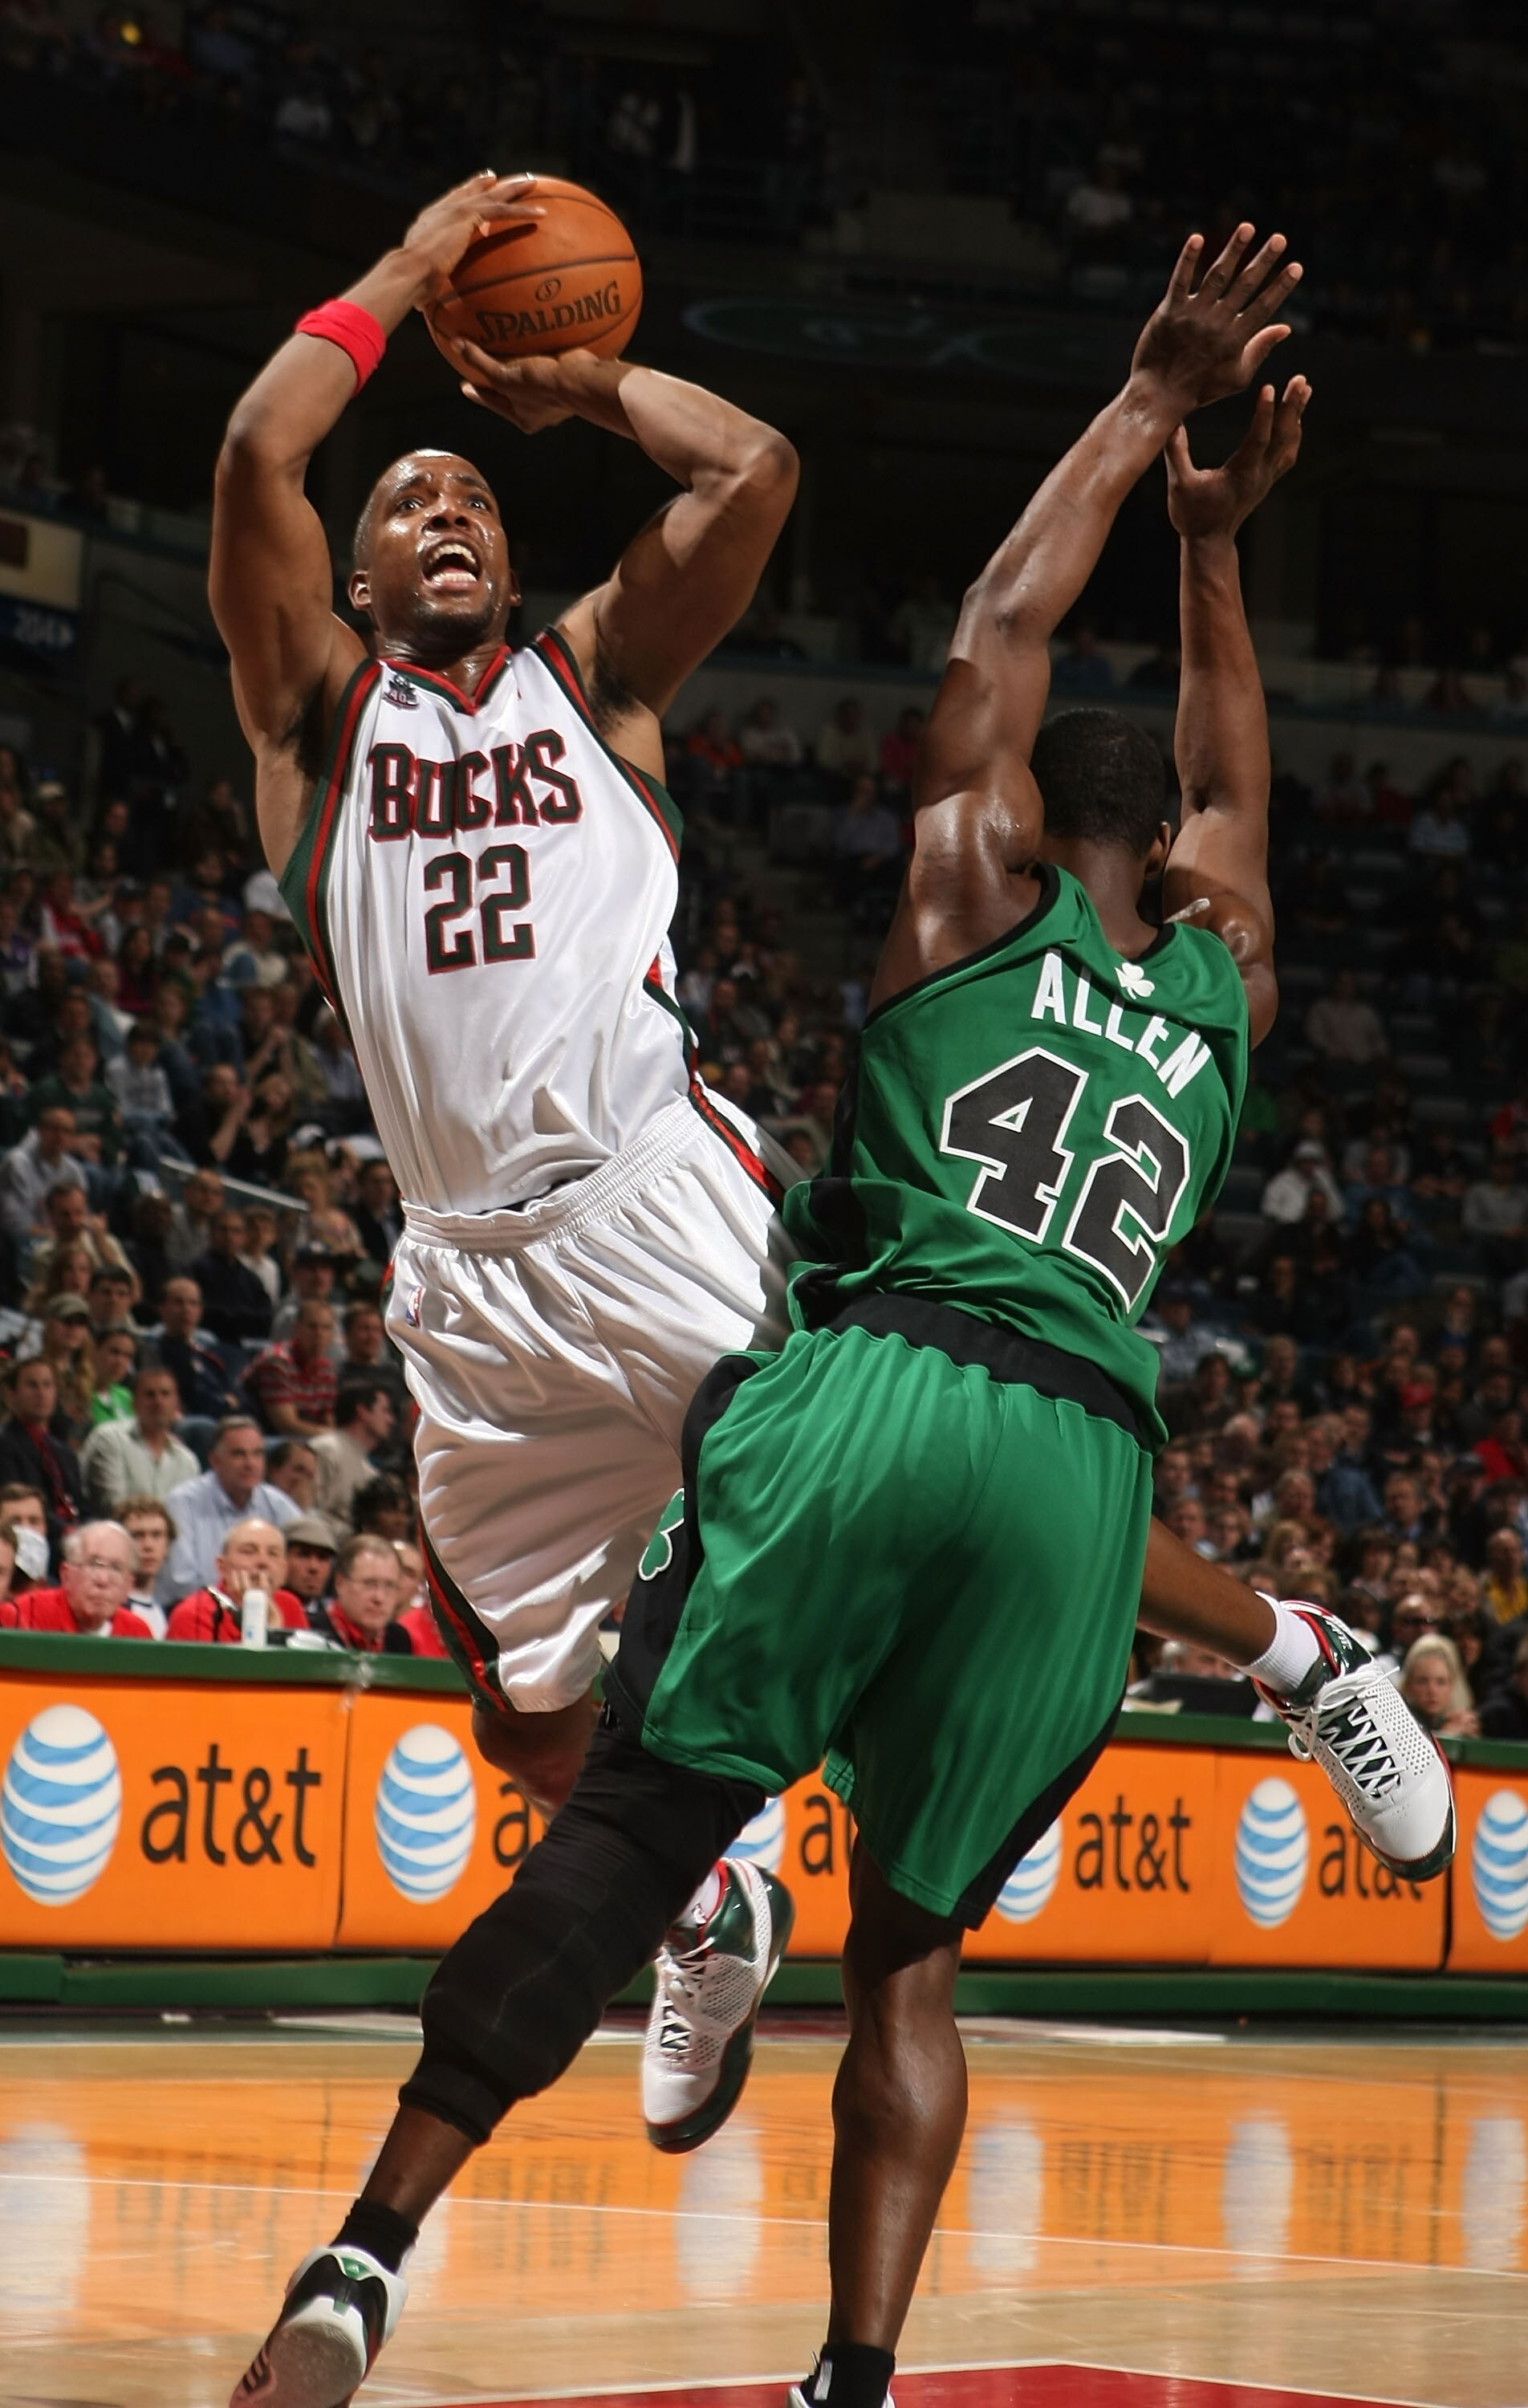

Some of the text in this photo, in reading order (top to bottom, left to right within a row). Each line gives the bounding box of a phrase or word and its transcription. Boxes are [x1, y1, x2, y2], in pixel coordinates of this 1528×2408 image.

[475, 280, 621, 343] SPALDING
[368, 728, 584, 843] BUCKS
[424, 843, 537, 976] 22
[1030, 947, 1213, 1100] ALLEN
[939, 1046, 1191, 1315] 42
[140, 1743, 322, 1868] at&t
[1075, 1794, 1191, 1893] at&t
